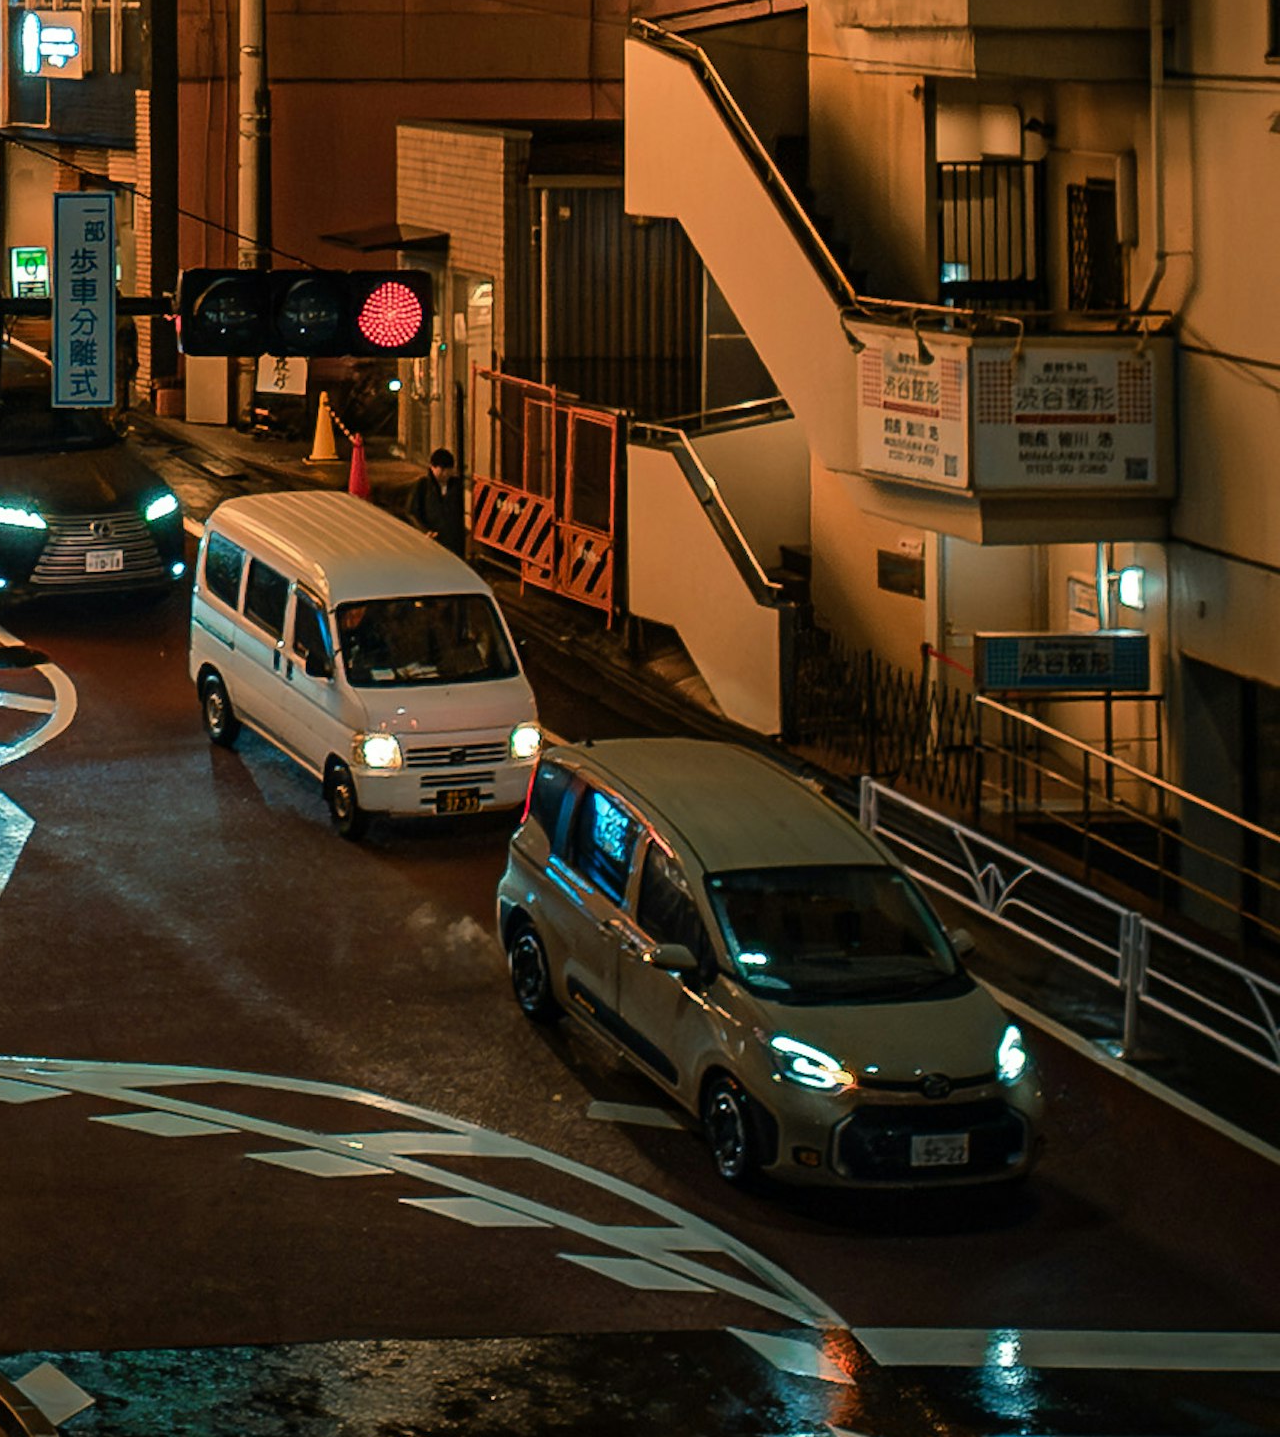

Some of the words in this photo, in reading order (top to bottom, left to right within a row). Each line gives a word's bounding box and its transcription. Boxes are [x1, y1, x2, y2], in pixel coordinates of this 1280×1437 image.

[82, 206, 108, 243] 一部
[69, 247, 98, 398] 歩車分離式
[1014, 386, 1115, 412] 渋谷整形
